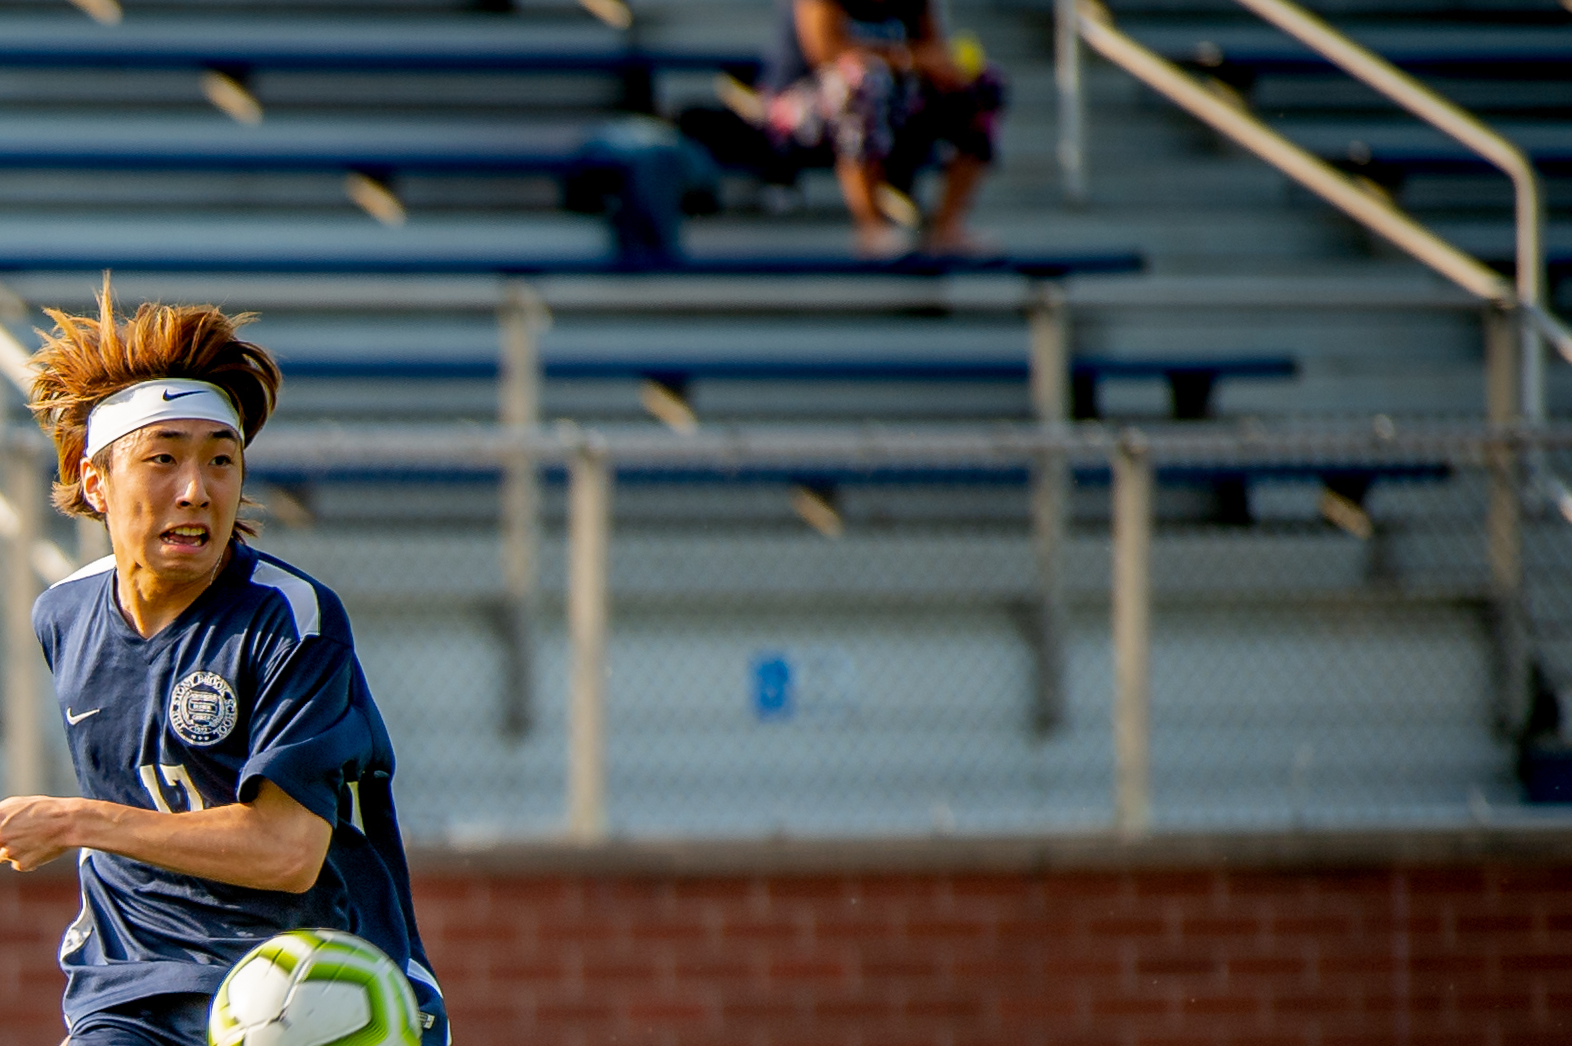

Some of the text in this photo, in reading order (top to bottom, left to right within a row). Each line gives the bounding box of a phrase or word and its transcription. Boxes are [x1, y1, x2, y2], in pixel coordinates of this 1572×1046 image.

[173, 674, 235, 736] THE STONY BROOK SCHOOL
